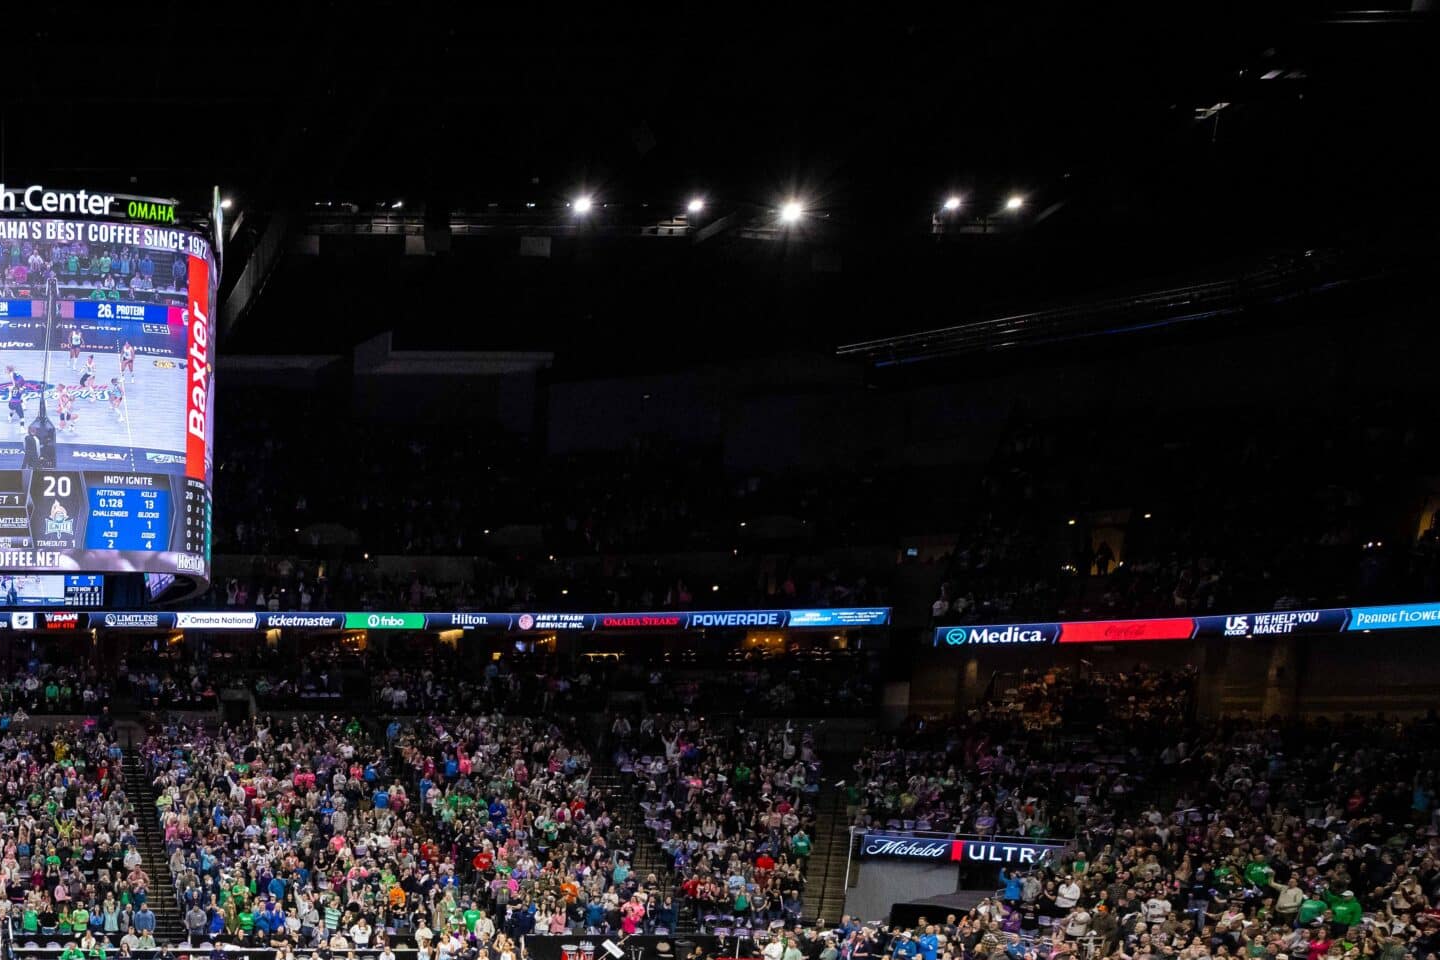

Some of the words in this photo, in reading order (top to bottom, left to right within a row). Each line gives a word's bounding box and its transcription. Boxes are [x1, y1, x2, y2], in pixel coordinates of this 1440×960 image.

[24, 185, 116, 215] Center
[128, 201, 175, 222] OMAHA
[46, 222, 85, 241] BEST
[88, 223, 141, 246] COFFEE
[143, 227, 186, 250] SINCE
[116, 304, 145, 317] PROTEIN
[188, 301, 210, 441] Baxter
[43, 476, 71, 497] 20
[104, 476, 125, 485] INDY
[125, 476, 153, 486] IGNITE
[186, 491, 194, 500] 20
[99, 498, 123, 508] 0.128
[145, 500, 154, 509] 13
[93, 510, 129, 518] CHALLENGES
[53, 613, 78, 622] RAW
[116, 614, 158, 622] LIMITLESS
[190, 616, 220, 624] Omaha
[222, 615, 254, 624] National
[267, 614, 335, 627] ticketmaster
[381, 616, 405, 626] fnbo
[603, 617, 641, 626] OMAHA
[642, 615, 679, 626] STEAKS
[692, 613, 778, 627] POWERADE
[1255, 615, 1270, 625] WE
[1271, 613, 1296, 625] HELP
[1298, 611, 1319, 623] YOU
[1357, 611, 1398, 626] PRAIRIE
[1400, 609, 1440, 622] FLOWE
[1253, 623, 1281, 635] MAKE
[1282, 622, 1295, 633] IT
[866, 839, 950, 858] Michelob
